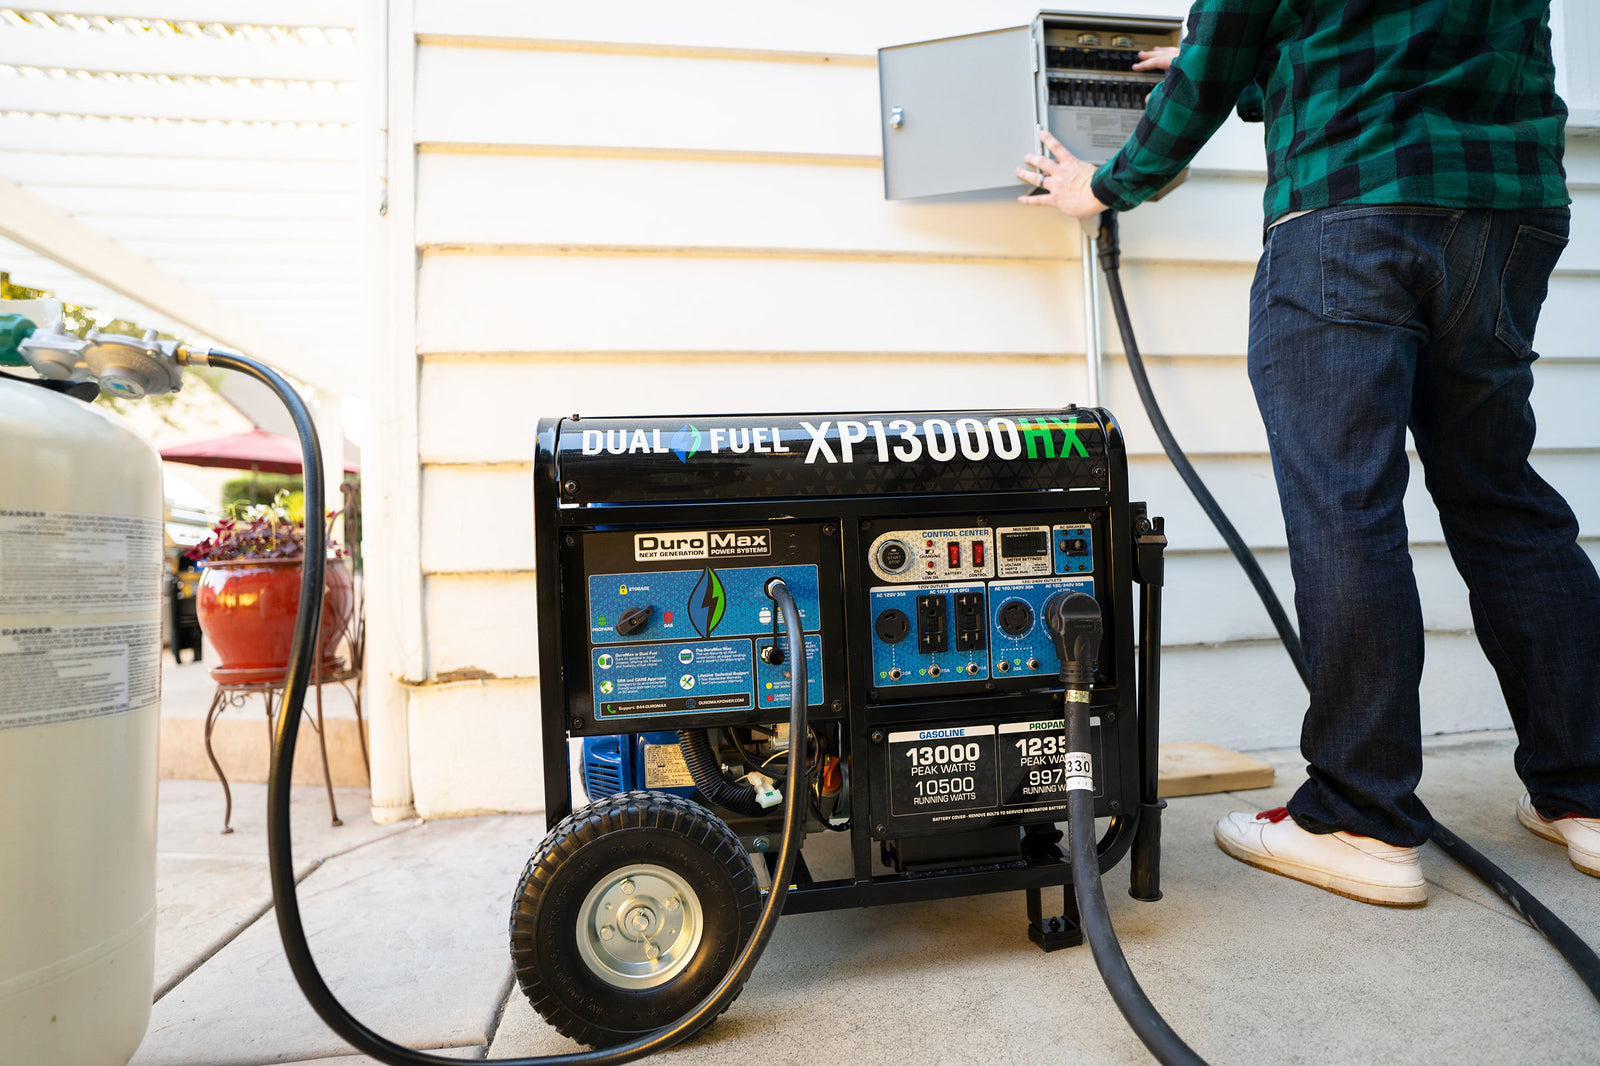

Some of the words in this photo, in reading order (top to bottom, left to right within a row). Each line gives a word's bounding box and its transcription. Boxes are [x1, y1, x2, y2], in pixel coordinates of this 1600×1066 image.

[582, 429, 669, 455] DUAL
[710, 427, 789, 453] FUEL
[799, 417, 1091, 464] XP13000HX
[639, 537, 704, 550] Duro
[711, 532, 766, 548] Max
[1029, 721, 1065, 730] PROPAN
[919, 728, 965, 739] GASOLINE
[1015, 736, 1065, 756] 1235
[906, 743, 980, 766] 13000
[1020, 756, 1046, 768] PEAK
[911, 765, 938, 776] PEAK
[940, 762, 976, 774] WATTS
[1029, 769, 1065, 786] 997
[915, 776, 974, 796] 10500
[1022, 785, 1057, 796] RUNNING
[913, 795, 949, 805] RUNNING
[950, 792, 976, 803] WATTS
